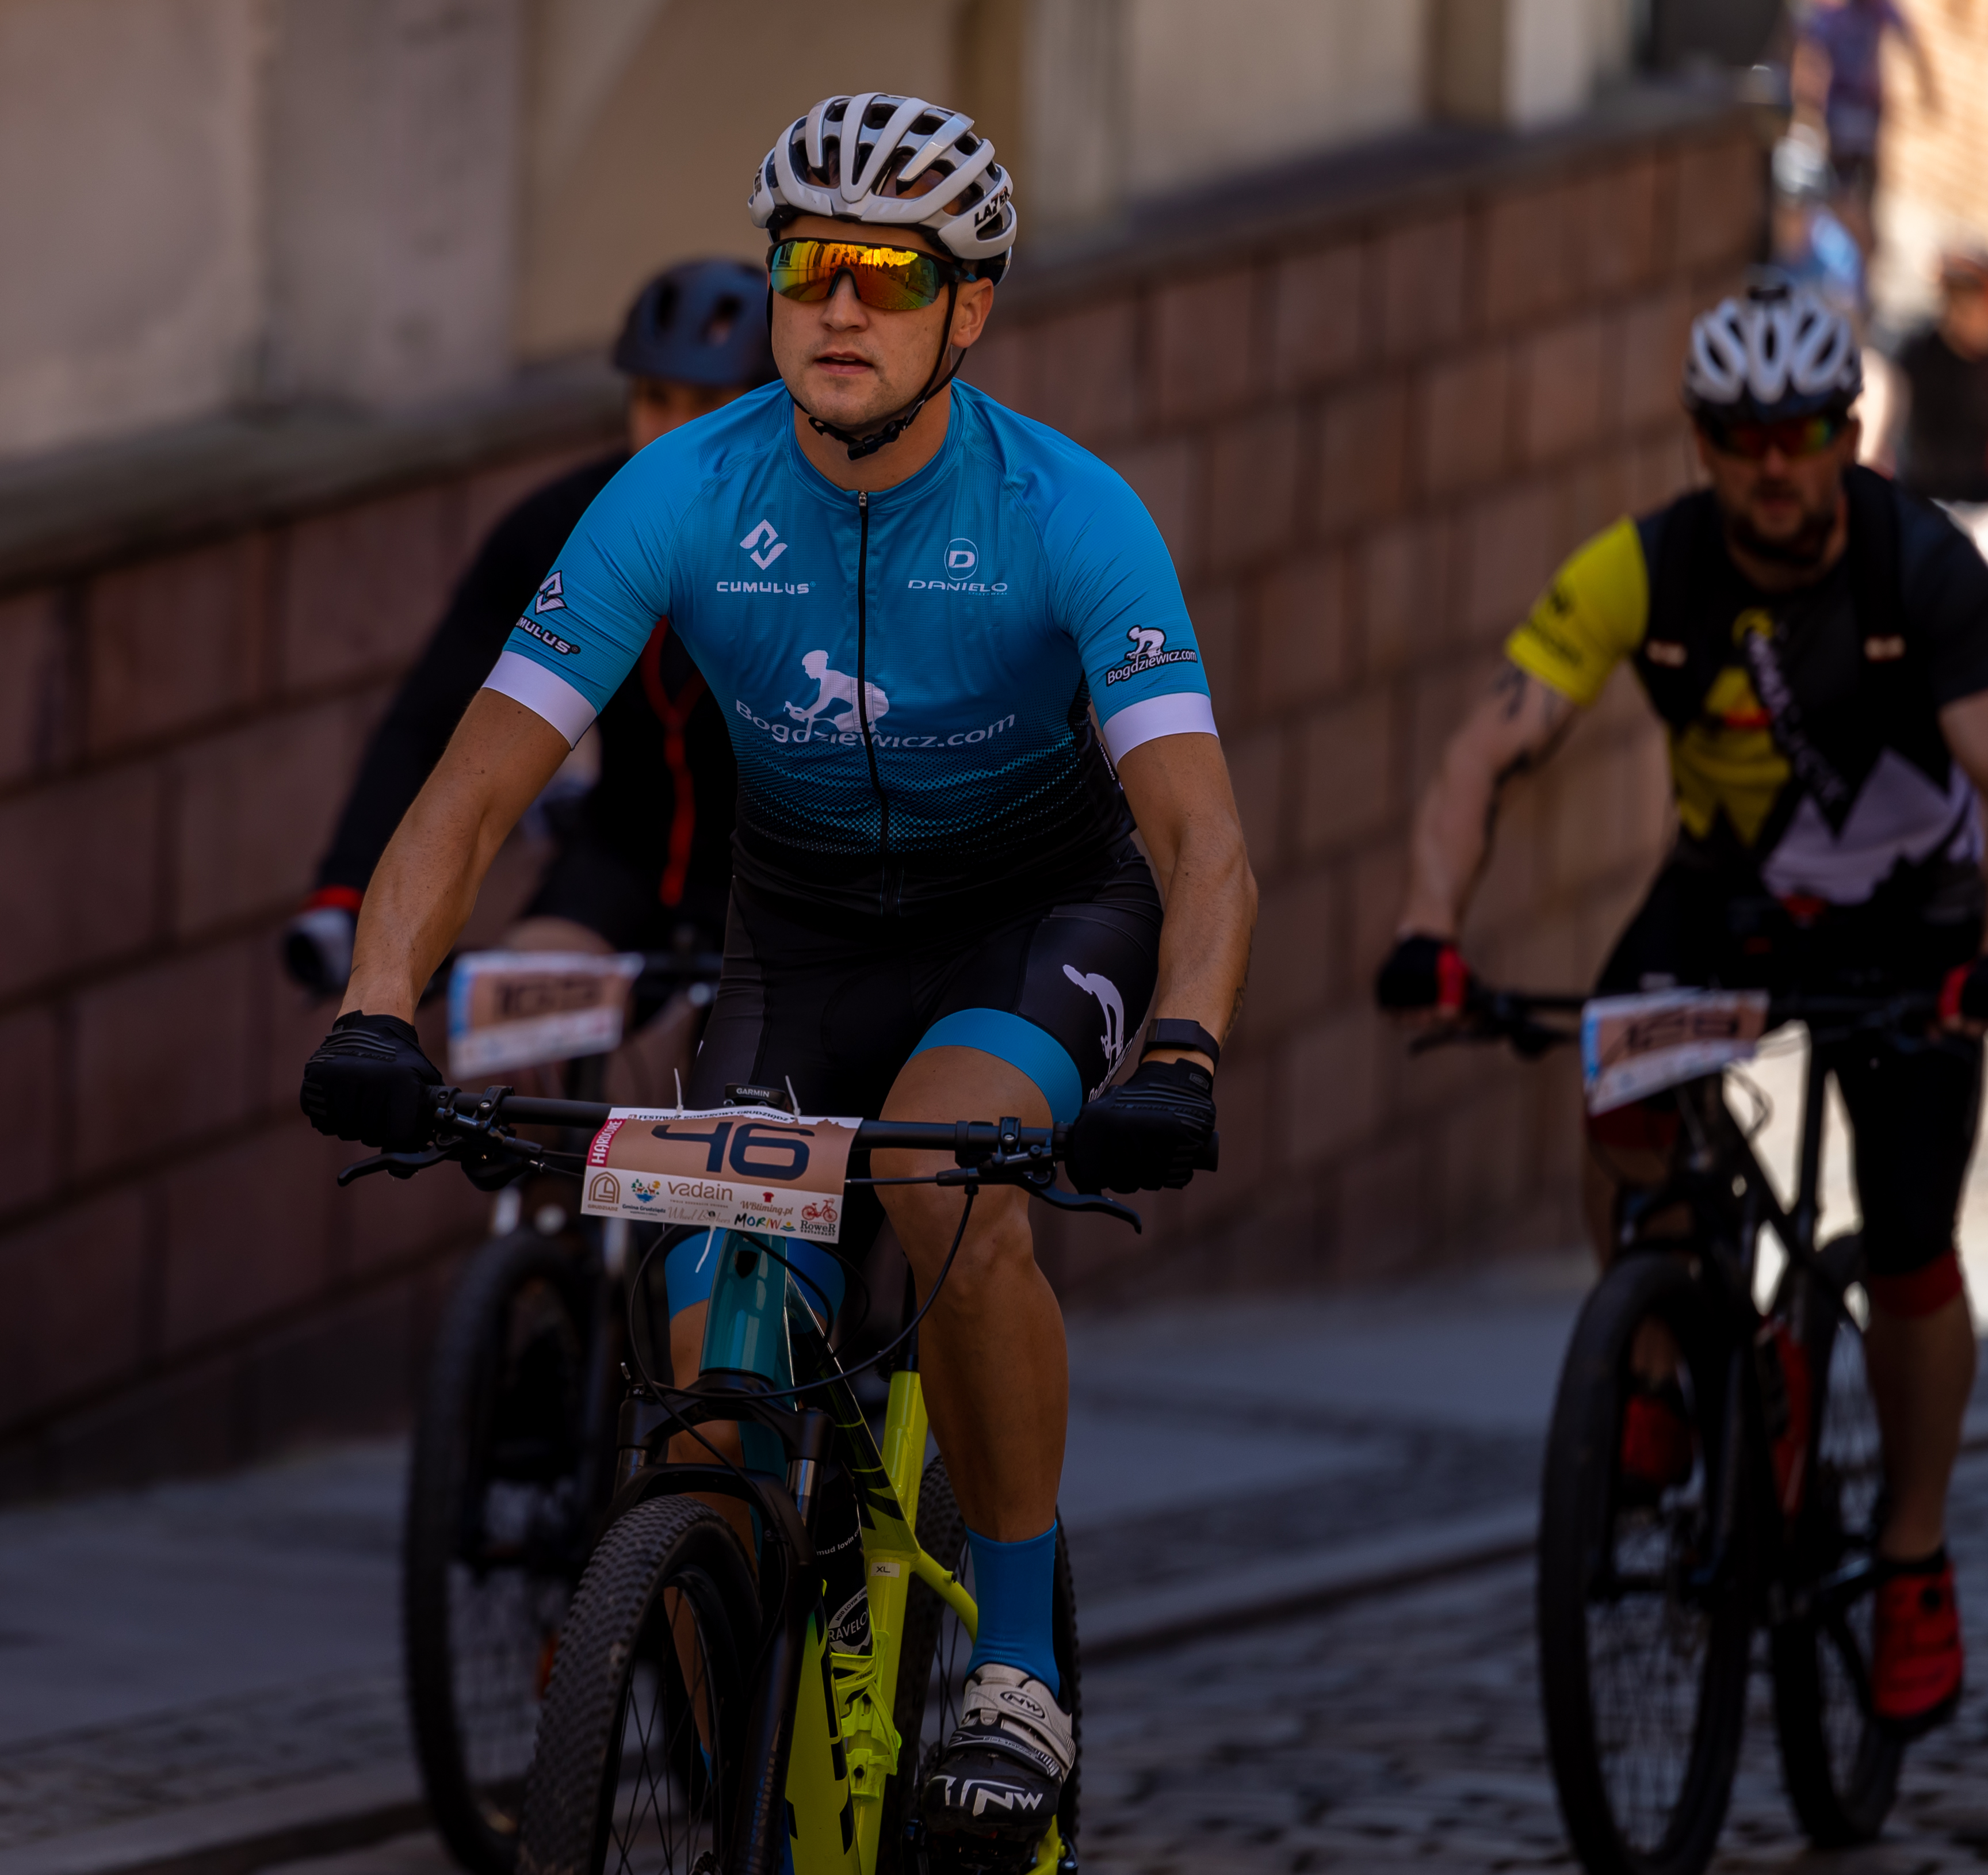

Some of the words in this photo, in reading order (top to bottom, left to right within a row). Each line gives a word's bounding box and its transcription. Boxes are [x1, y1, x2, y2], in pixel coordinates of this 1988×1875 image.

[948, 550, 975, 568] D
[908, 579, 1008, 593] DANIELO
[1107, 650, 1197, 685] Bogdziewicz.com
[736, 1087, 770, 1098] GARMIN
[651, 1121, 815, 1181] 46
[817, 1545, 836, 1556] mud
[837, 1536, 854, 1551] lovin
[835, 1610, 845, 1621] MUD
[1007, 1693, 1041, 1712] NW
[972, 1787, 1043, 1817] NW
